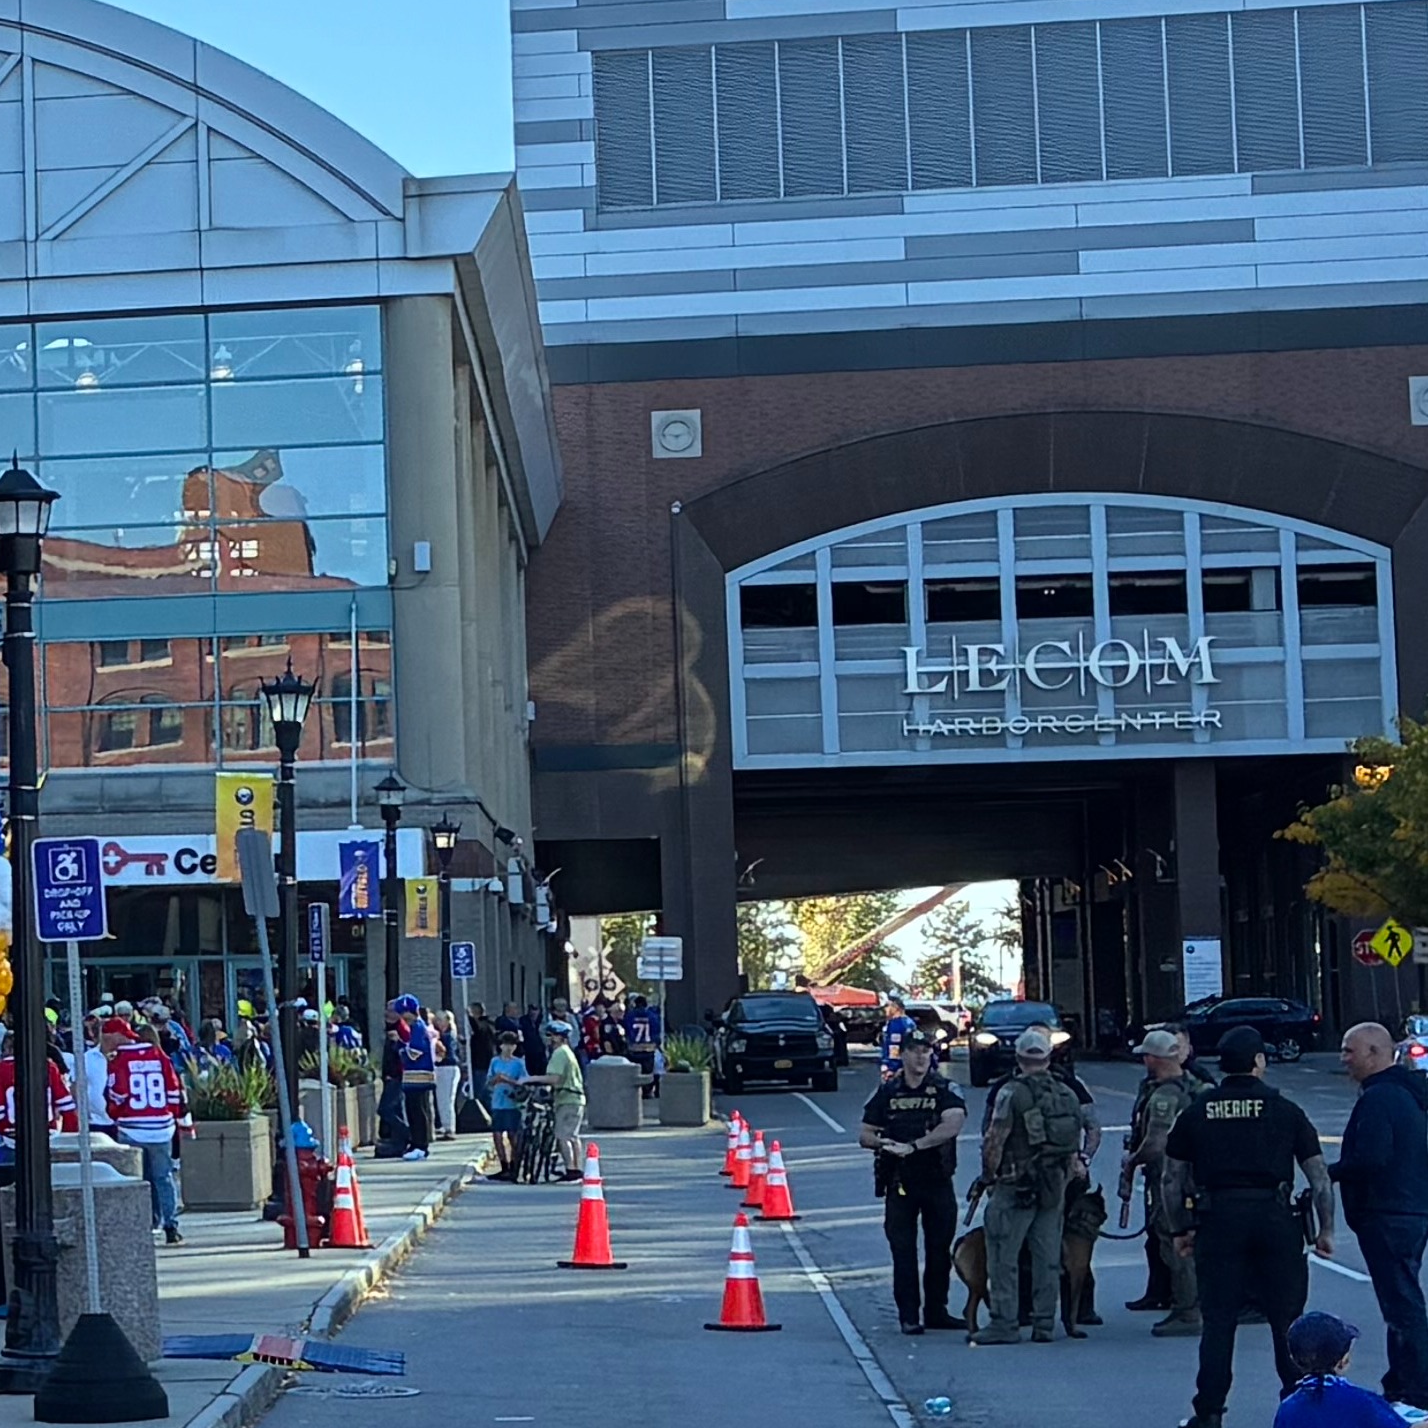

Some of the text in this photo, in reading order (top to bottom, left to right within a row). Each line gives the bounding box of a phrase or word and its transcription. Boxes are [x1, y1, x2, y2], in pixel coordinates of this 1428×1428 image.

[901, 636, 1221, 694] LECOM
[903, 709, 1223, 737] HARBORCENTER
[632, 1023, 652, 1042] 71
[129, 1073, 166, 1110] 98
[1206, 1099, 1264, 1119] SHERIFF
